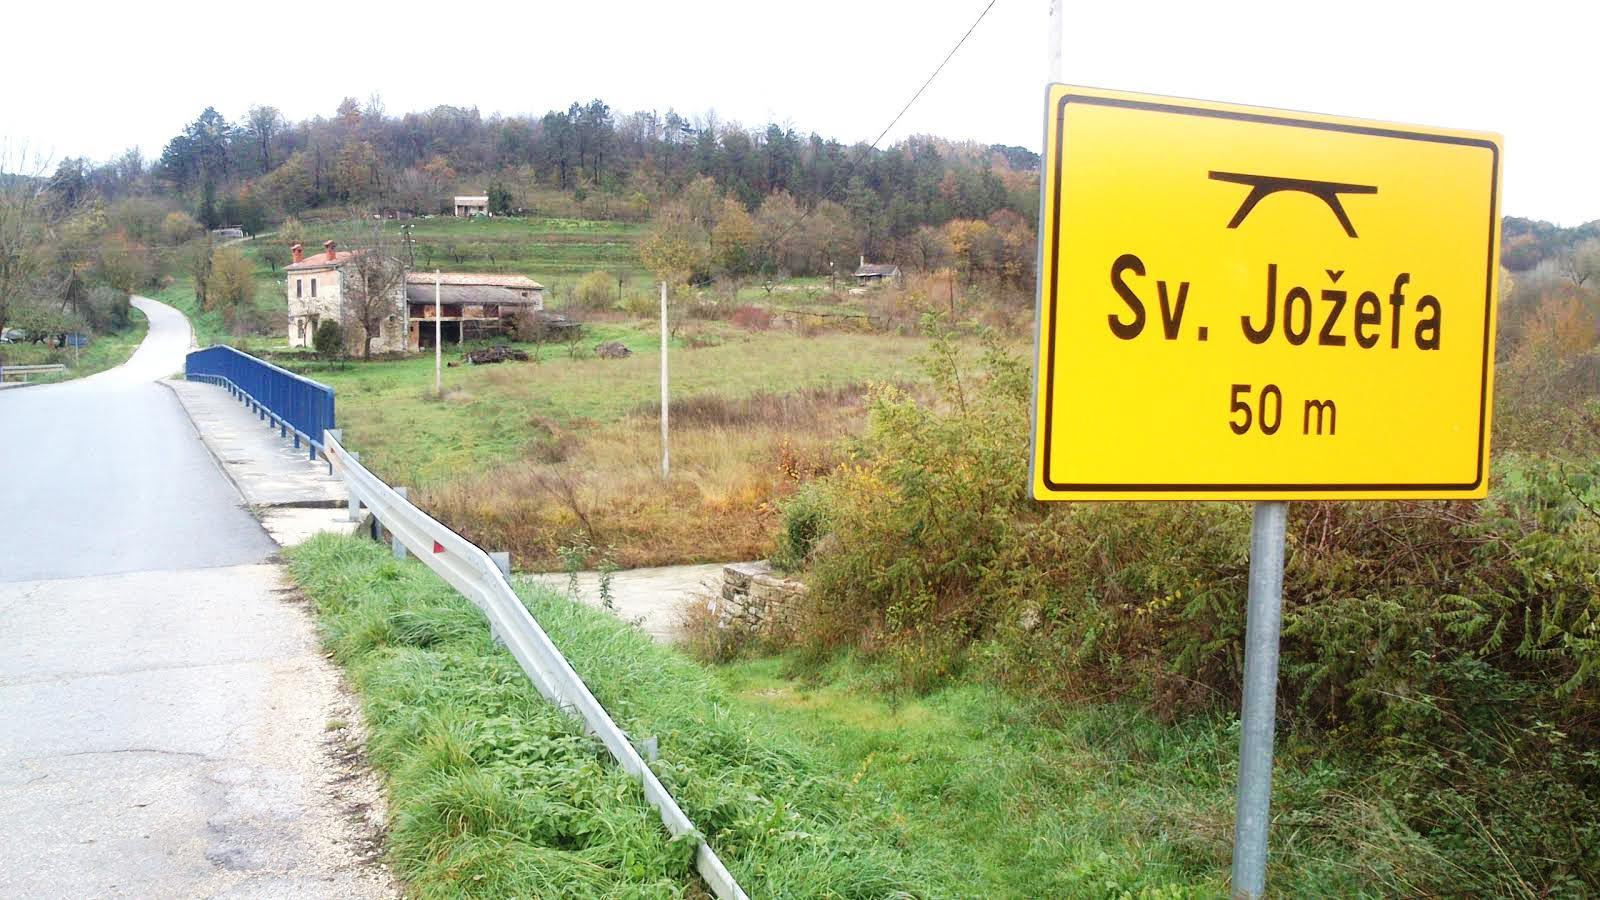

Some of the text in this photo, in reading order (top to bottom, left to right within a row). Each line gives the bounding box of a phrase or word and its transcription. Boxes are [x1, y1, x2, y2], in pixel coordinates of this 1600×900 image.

[1107, 253, 1442, 351] Sv. Jožefa
[1229, 384, 1336, 436] 50 m
